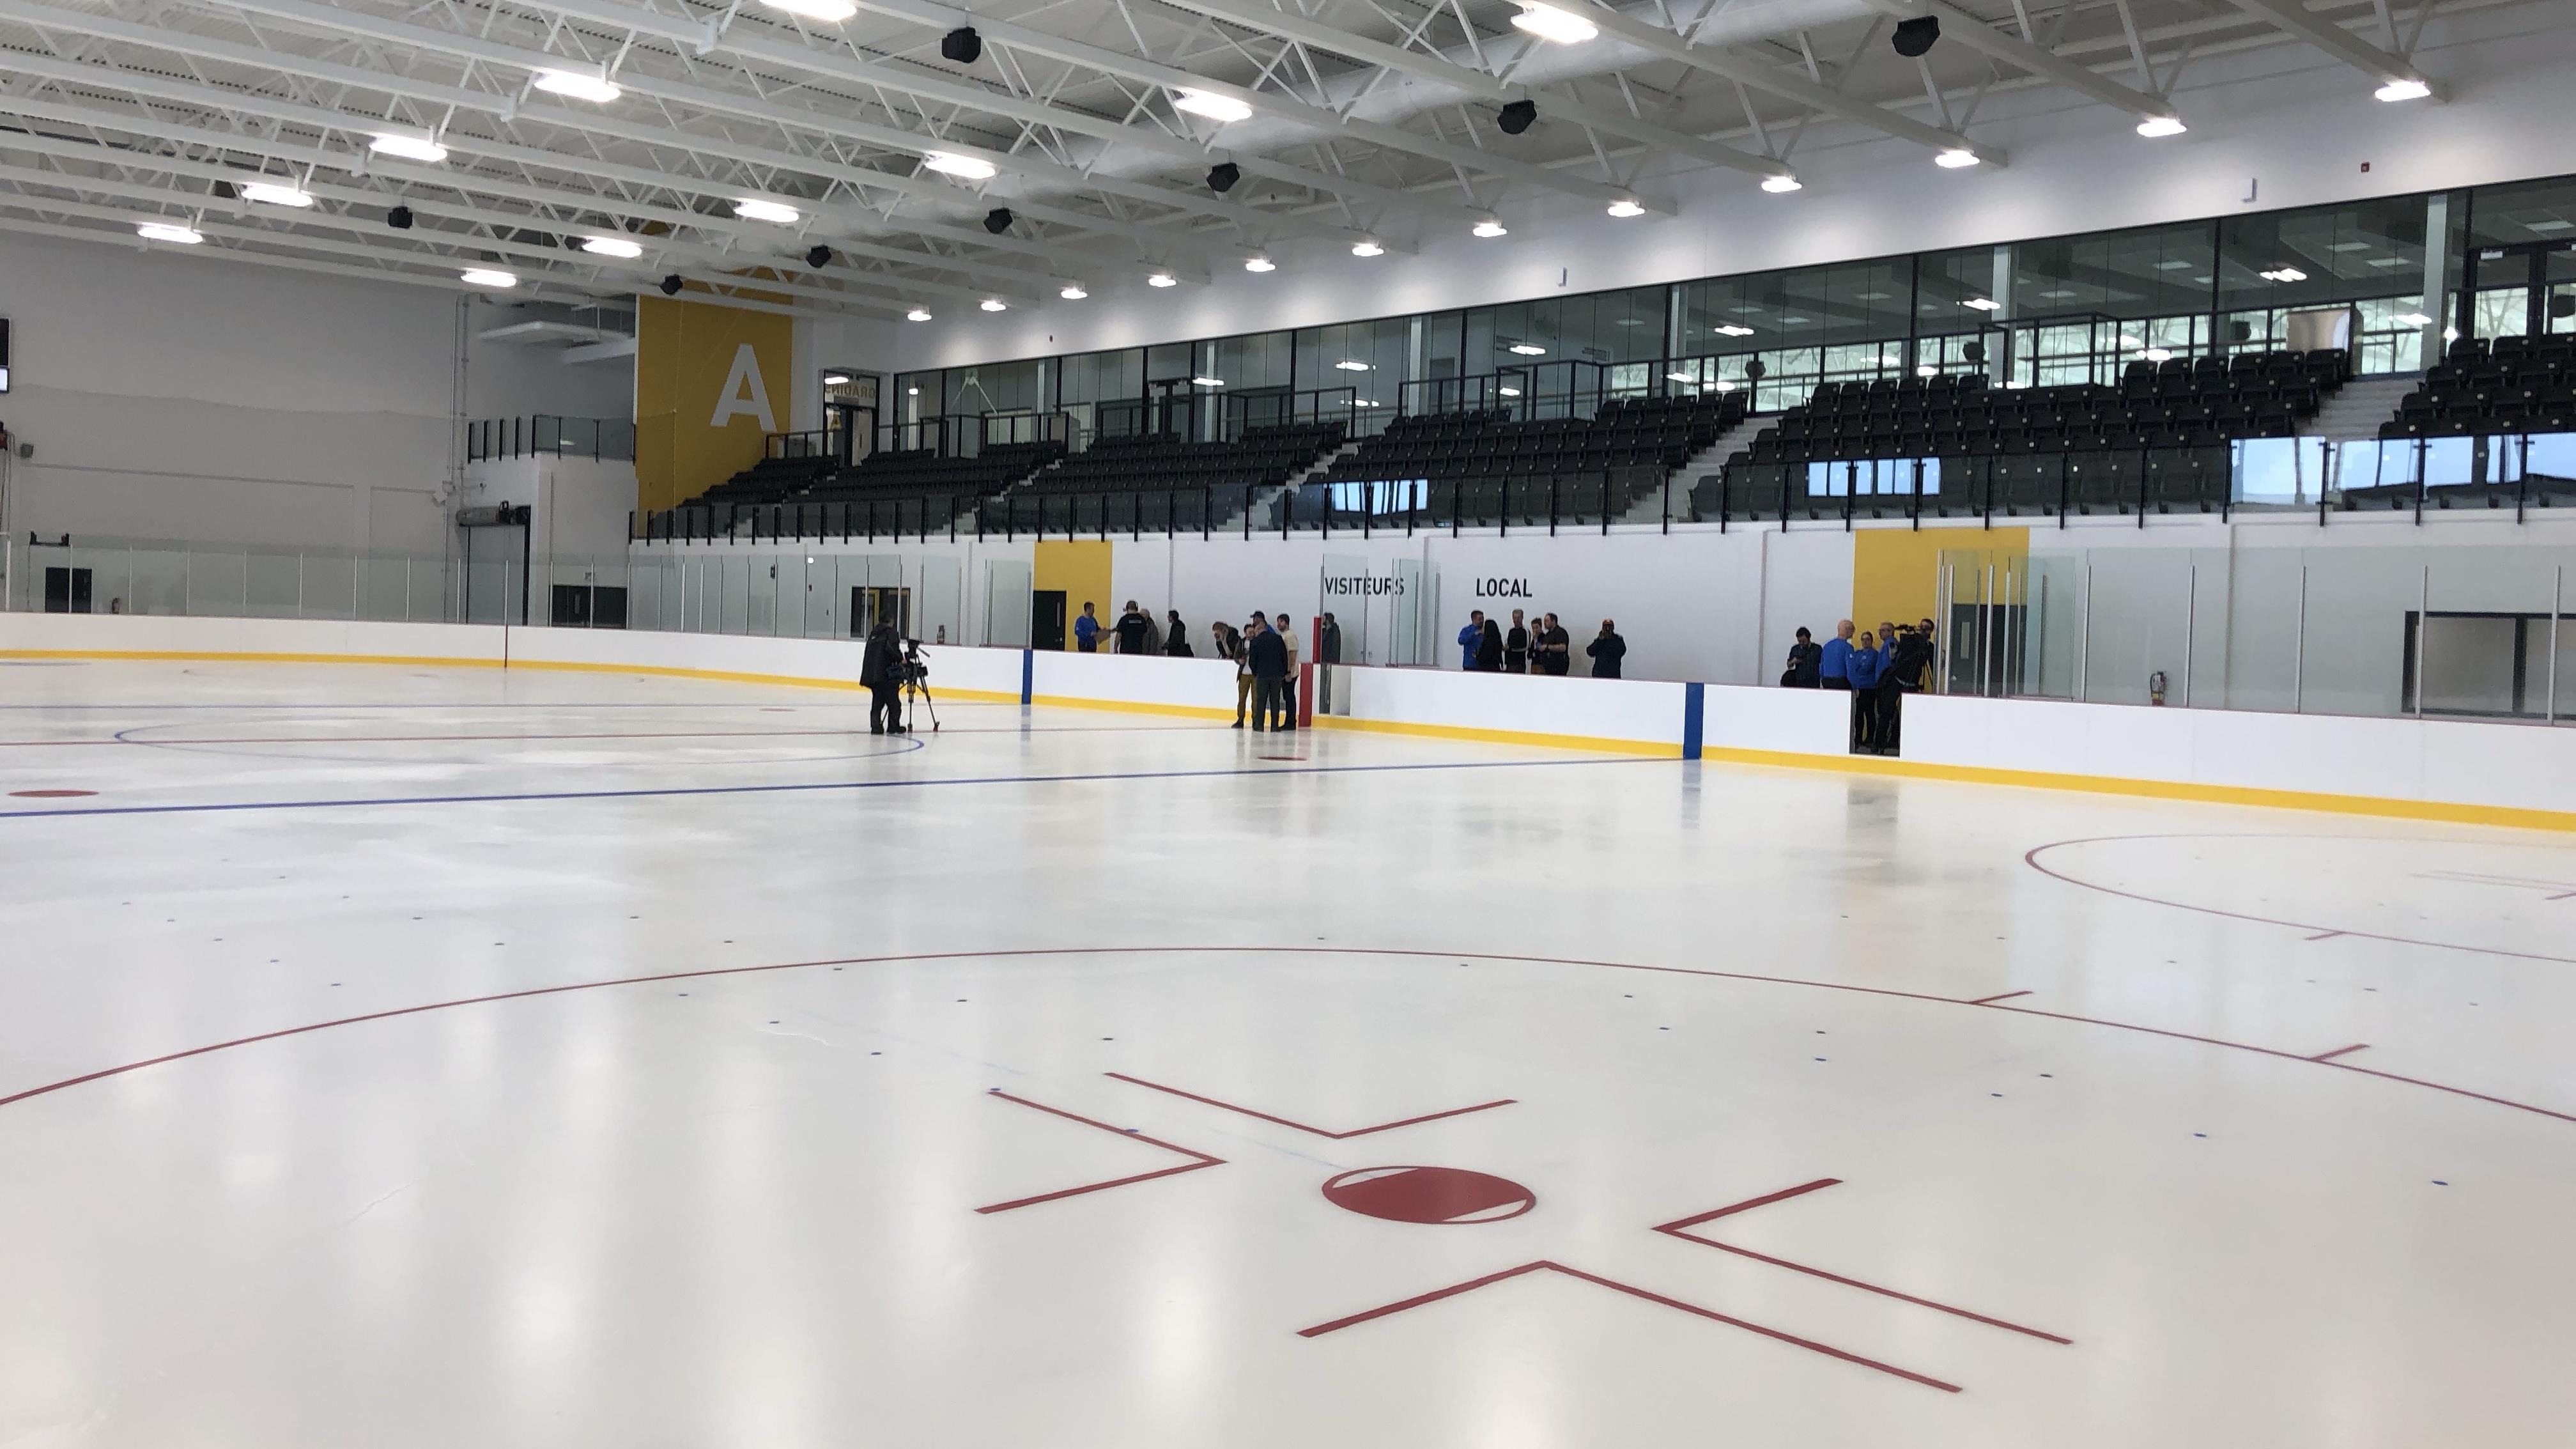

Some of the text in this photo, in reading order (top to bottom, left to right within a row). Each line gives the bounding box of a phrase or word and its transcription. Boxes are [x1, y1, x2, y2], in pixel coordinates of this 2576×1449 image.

[710, 343, 778, 432] A
[1325, 577, 1405, 596] VISITEURS
[1476, 577, 1533, 598] LOCAL
